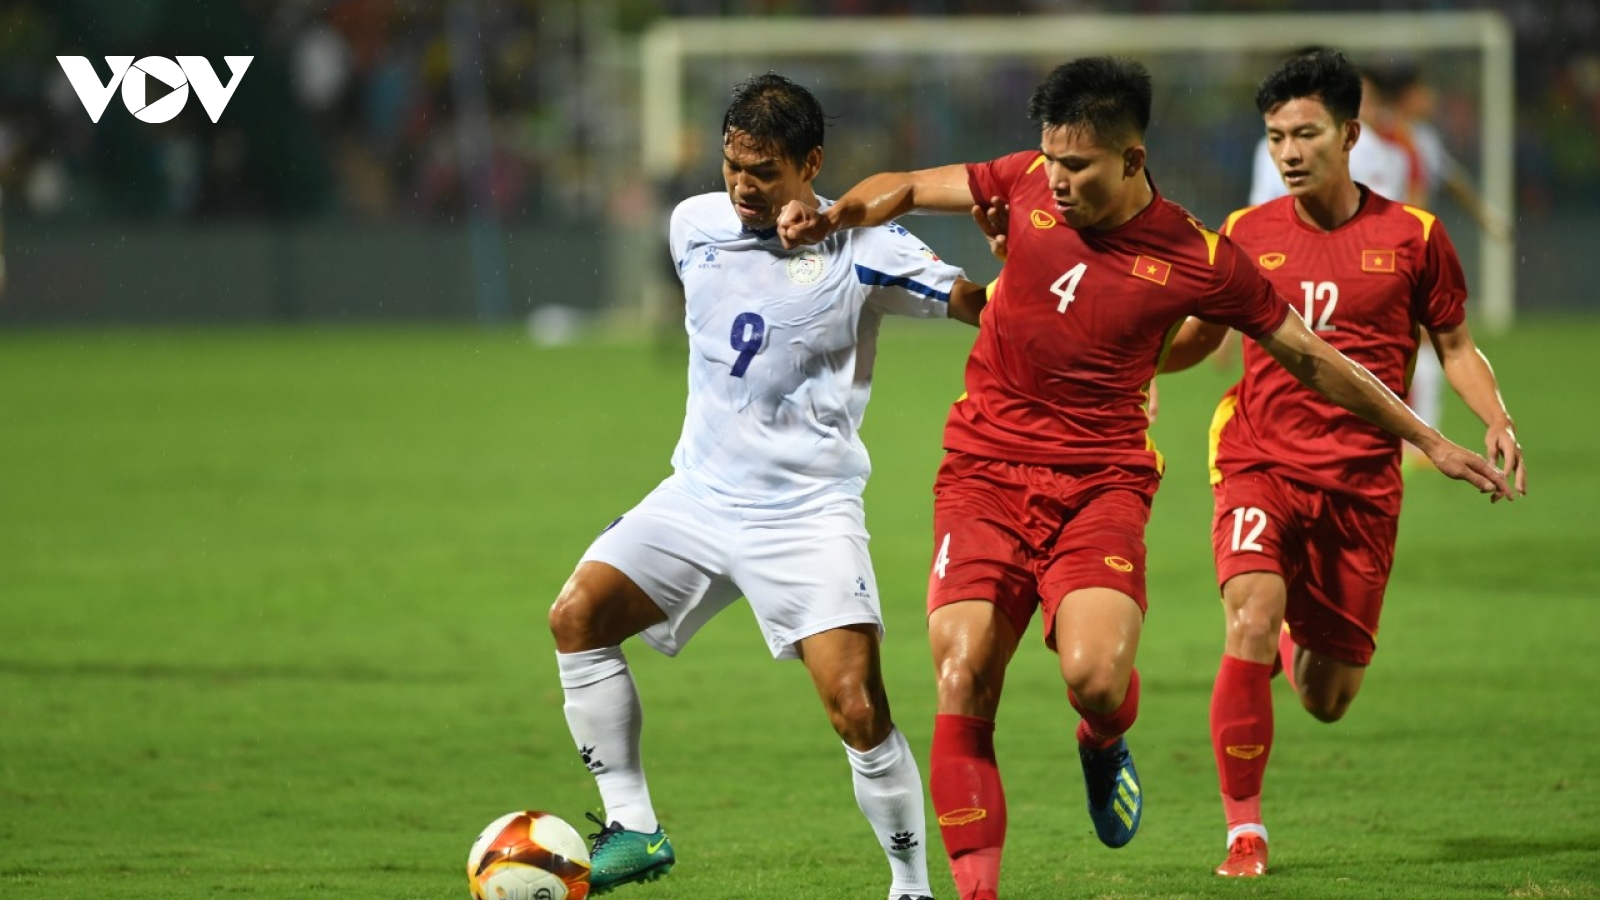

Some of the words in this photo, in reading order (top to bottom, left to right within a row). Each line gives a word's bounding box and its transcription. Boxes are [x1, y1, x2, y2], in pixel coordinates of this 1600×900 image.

[1050, 262, 1087, 314] 4
[1300, 280, 1339, 331] 12
[730, 312, 765, 378] 9
[1231, 507, 1267, 551] 12
[934, 532, 950, 579] 4
